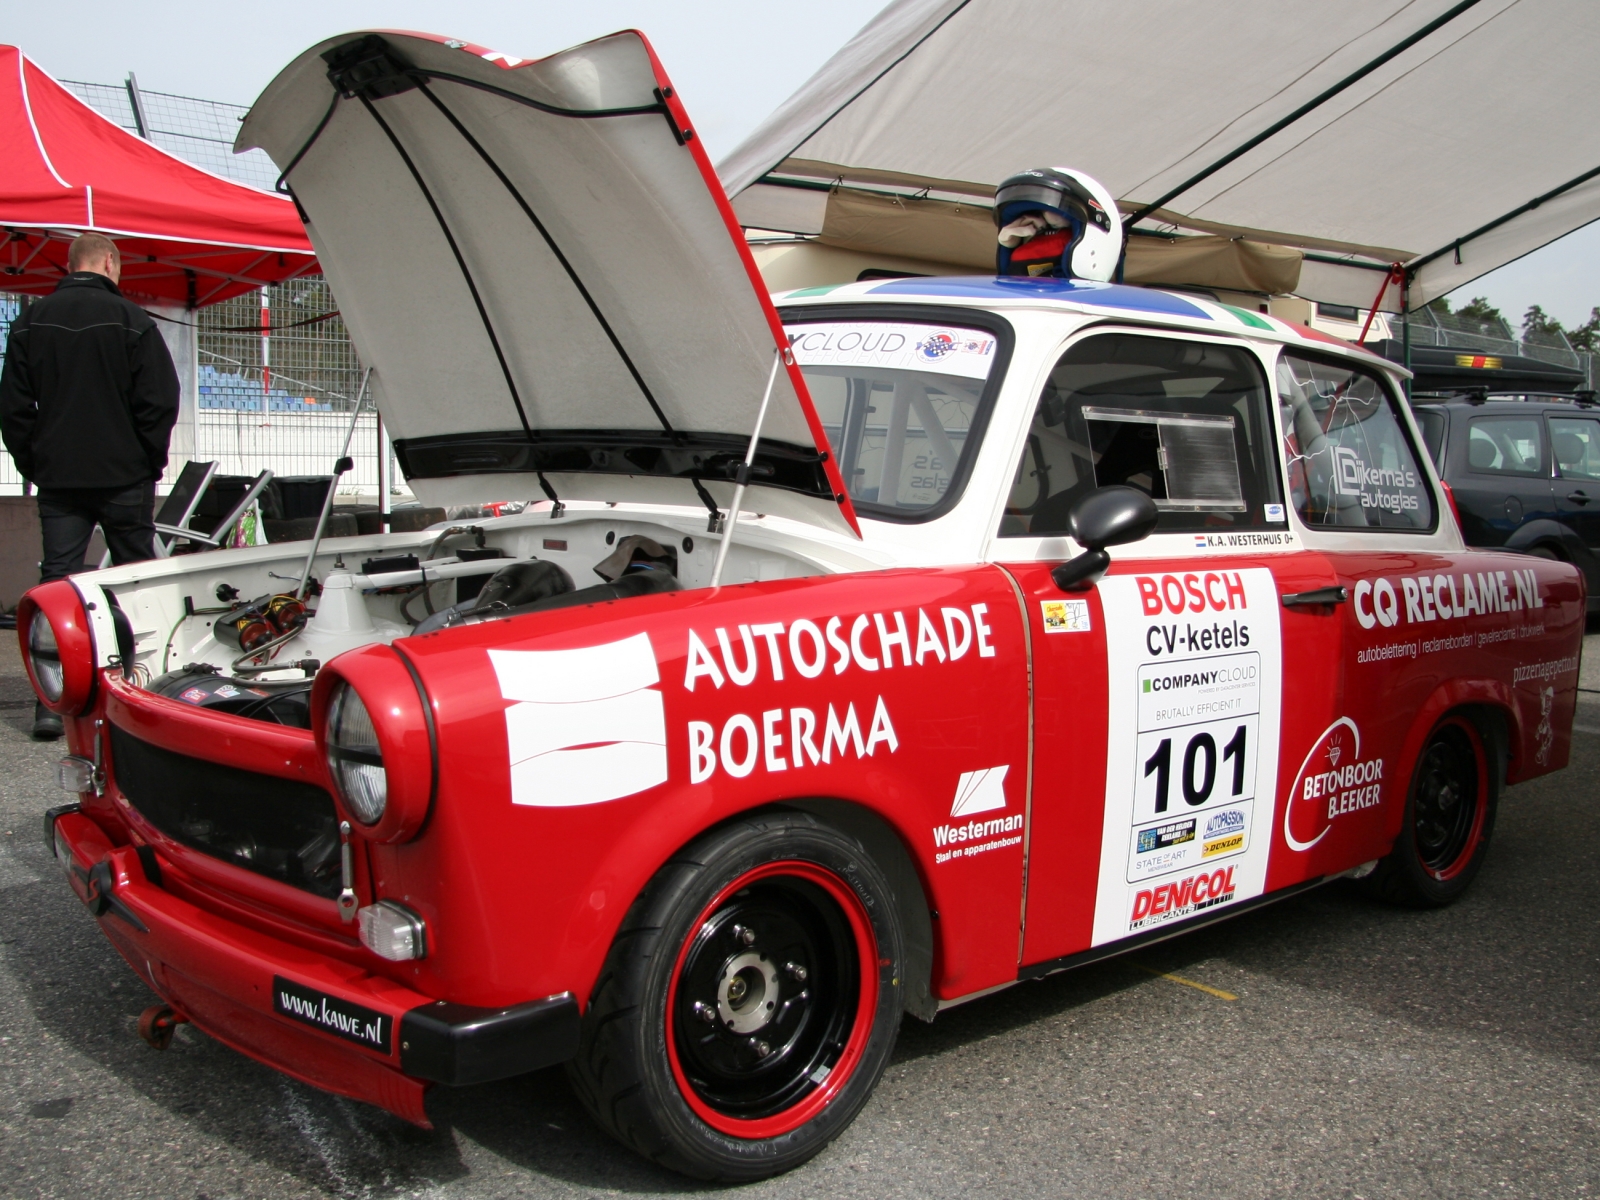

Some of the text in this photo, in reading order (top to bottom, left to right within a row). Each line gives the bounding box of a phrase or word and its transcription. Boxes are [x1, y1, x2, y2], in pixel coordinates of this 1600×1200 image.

[1360, 489, 1418, 514] autoglas
[1207, 535, 1227, 547] K.A.
[1227, 533, 1282, 546] WESTERHUIS
[1135, 572, 1247, 616] BOSCH
[1354, 569, 1543, 629] CQ RECLAME.NL
[683, 603, 996, 692] AUTOSCHADE
[1146, 620, 1250, 656] CV-ketels
[1357, 641, 1417, 663] autobelettering
[1422, 633, 1473, 653] reclameborden
[1478, 627, 1516, 648] gevelreclame
[1152, 665, 1257, 692] COMPANYCLOUD
[1156, 698, 1242, 721] BRUTALLY EFFICIENT IT
[687, 695, 899, 785] BOERMA
[1144, 725, 1247, 814] 101
[1303, 758, 1383, 800] BETONBOOR
[1328, 784, 1381, 819] BLEEKER
[933, 814, 1023, 847] Westerman
[1205, 811, 1244, 833] AUTOPASSION
[935, 835, 1022, 864] Staal en apparatenbouw
[1136, 855, 1162, 869] STATE
[1171, 849, 1187, 861] ART
[1210, 837, 1242, 851] DUNLOP
